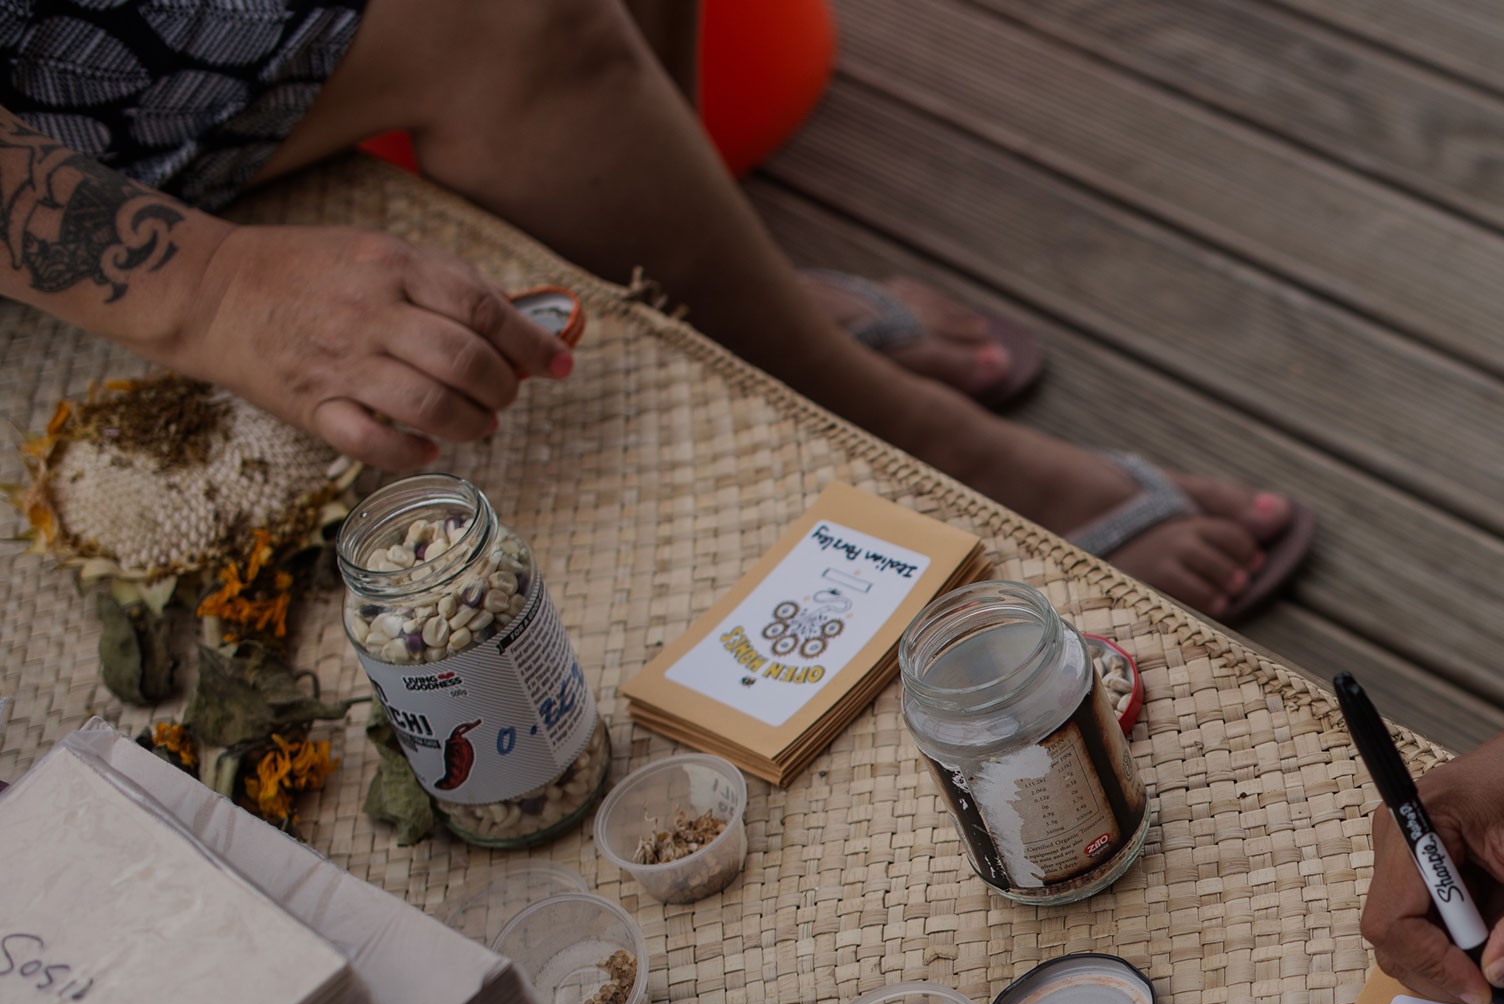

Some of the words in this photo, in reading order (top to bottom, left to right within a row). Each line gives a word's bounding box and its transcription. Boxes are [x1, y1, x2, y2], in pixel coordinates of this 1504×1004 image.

[811, 525, 862, 561] Parsley
[865, 551, 918, 578] Italian
[719, 625, 770, 673] HOMES
[402, 675, 438, 685] LIVING
[405, 677, 462, 691] GOODNESS
[764, 661, 826, 685] OPEN
[1026, 841, 1054, 853] Certified
[1055, 832, 1080, 847] Organic
[1422, 833, 1465, 903] Sharpie
